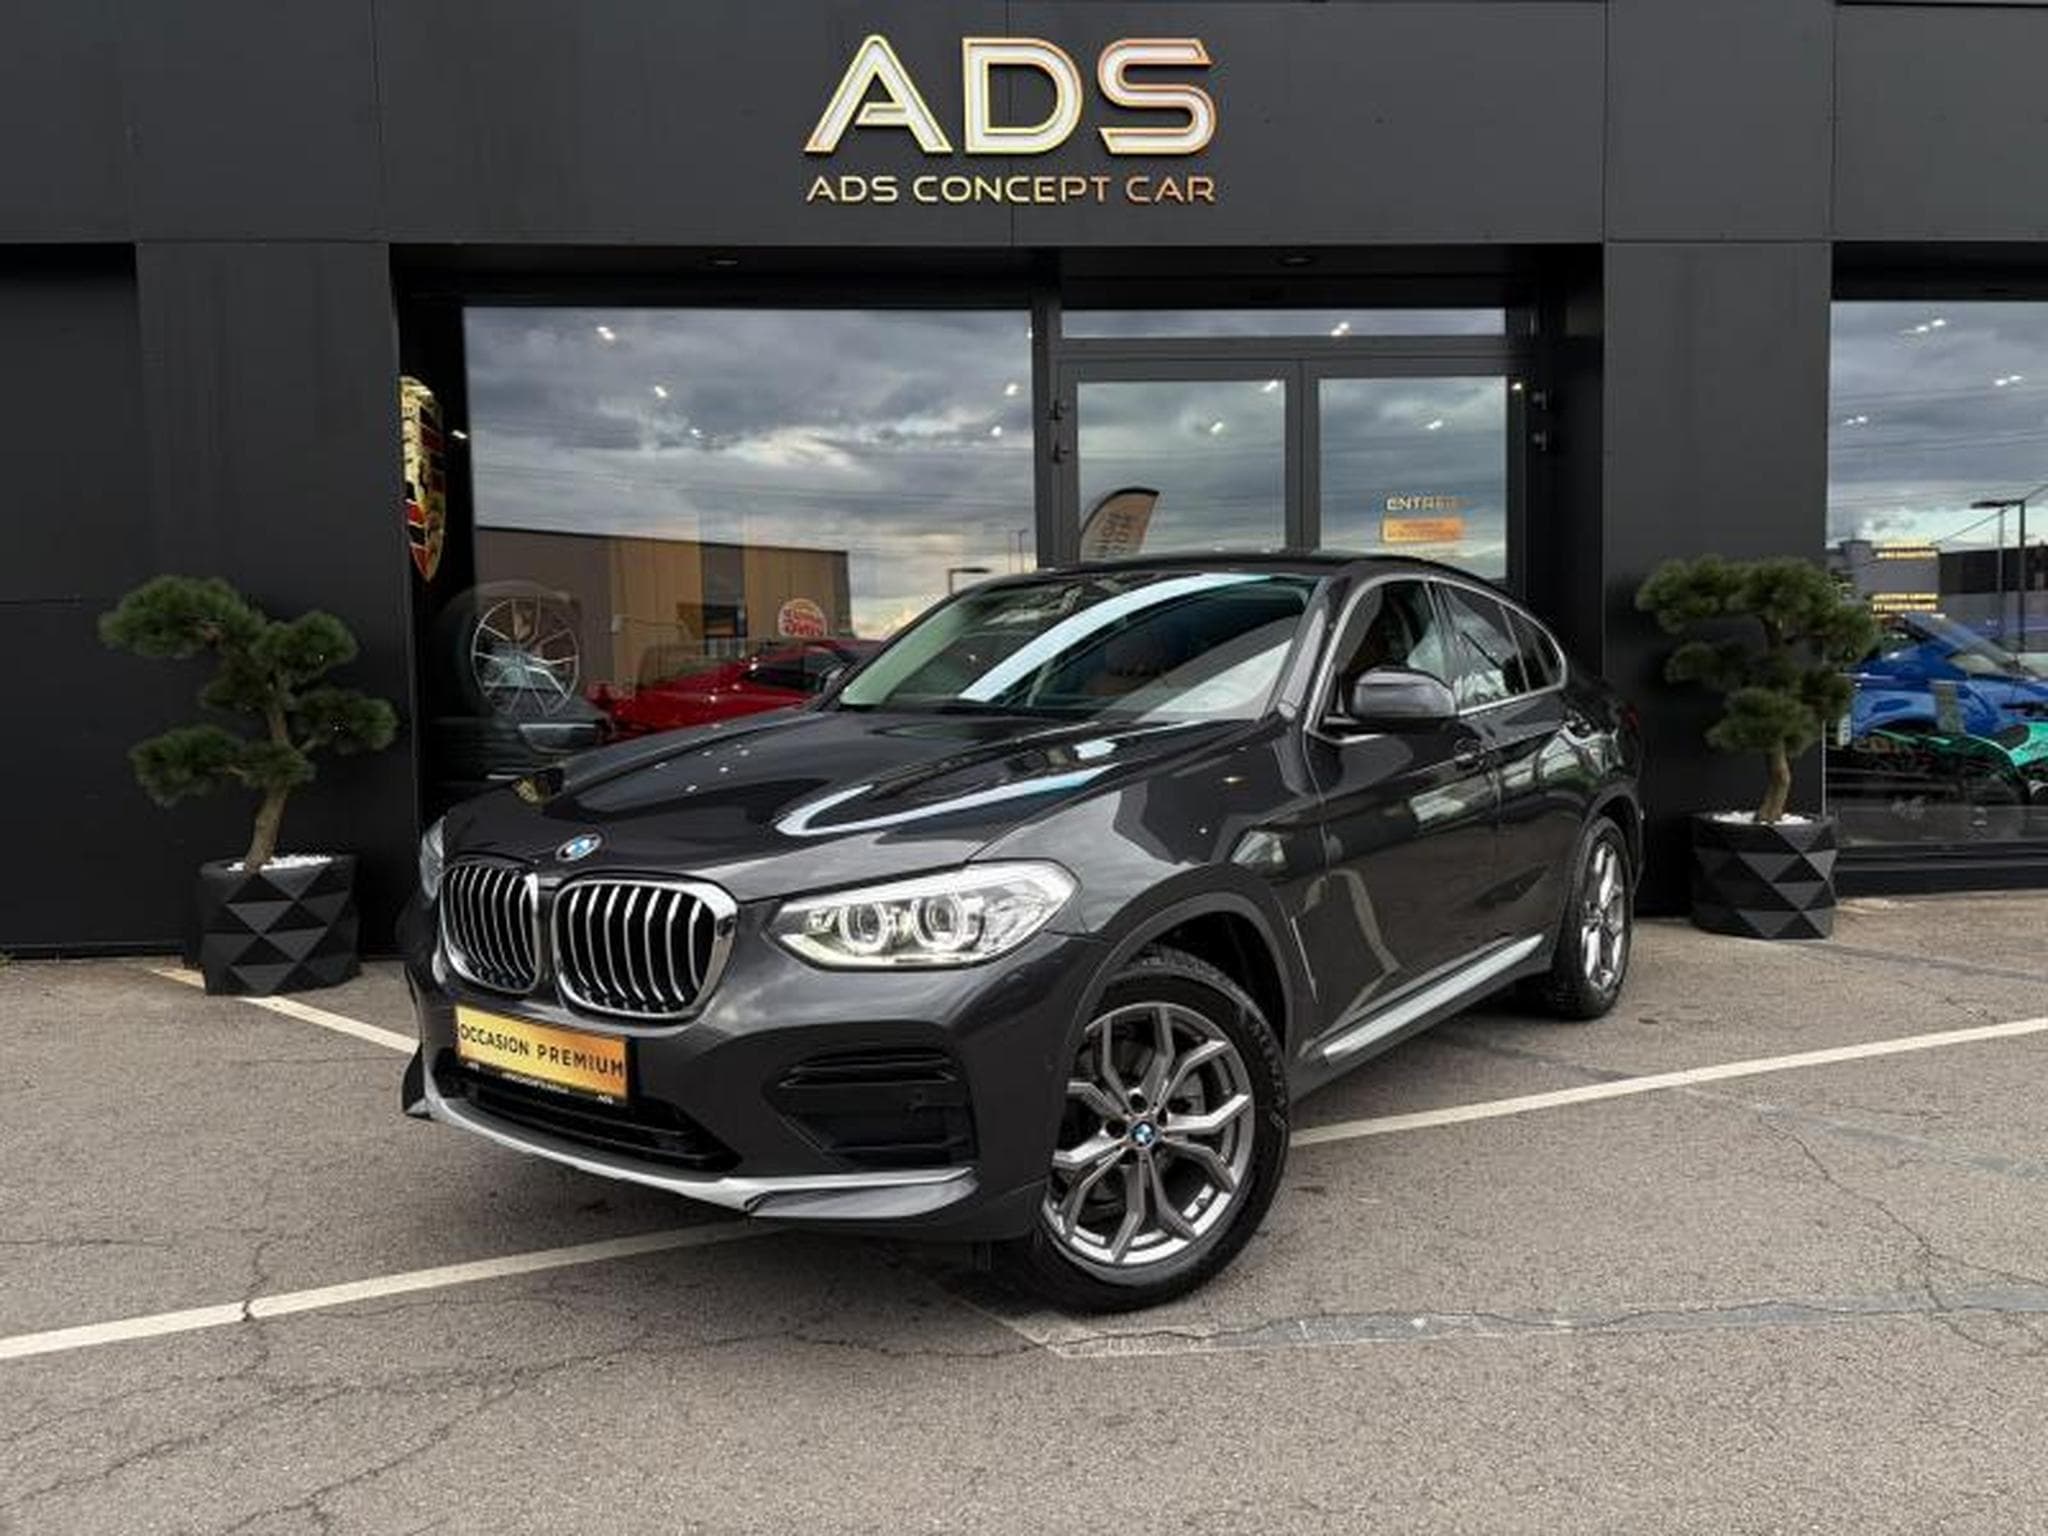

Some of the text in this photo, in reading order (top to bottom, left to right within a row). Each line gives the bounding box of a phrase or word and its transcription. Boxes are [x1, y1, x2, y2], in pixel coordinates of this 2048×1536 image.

[803, 34, 1217, 155] ADS
[806, 176, 1216, 202] ADS CONCEPT CAR
[459, 1022, 624, 1078] OCCASION PREMIUM
